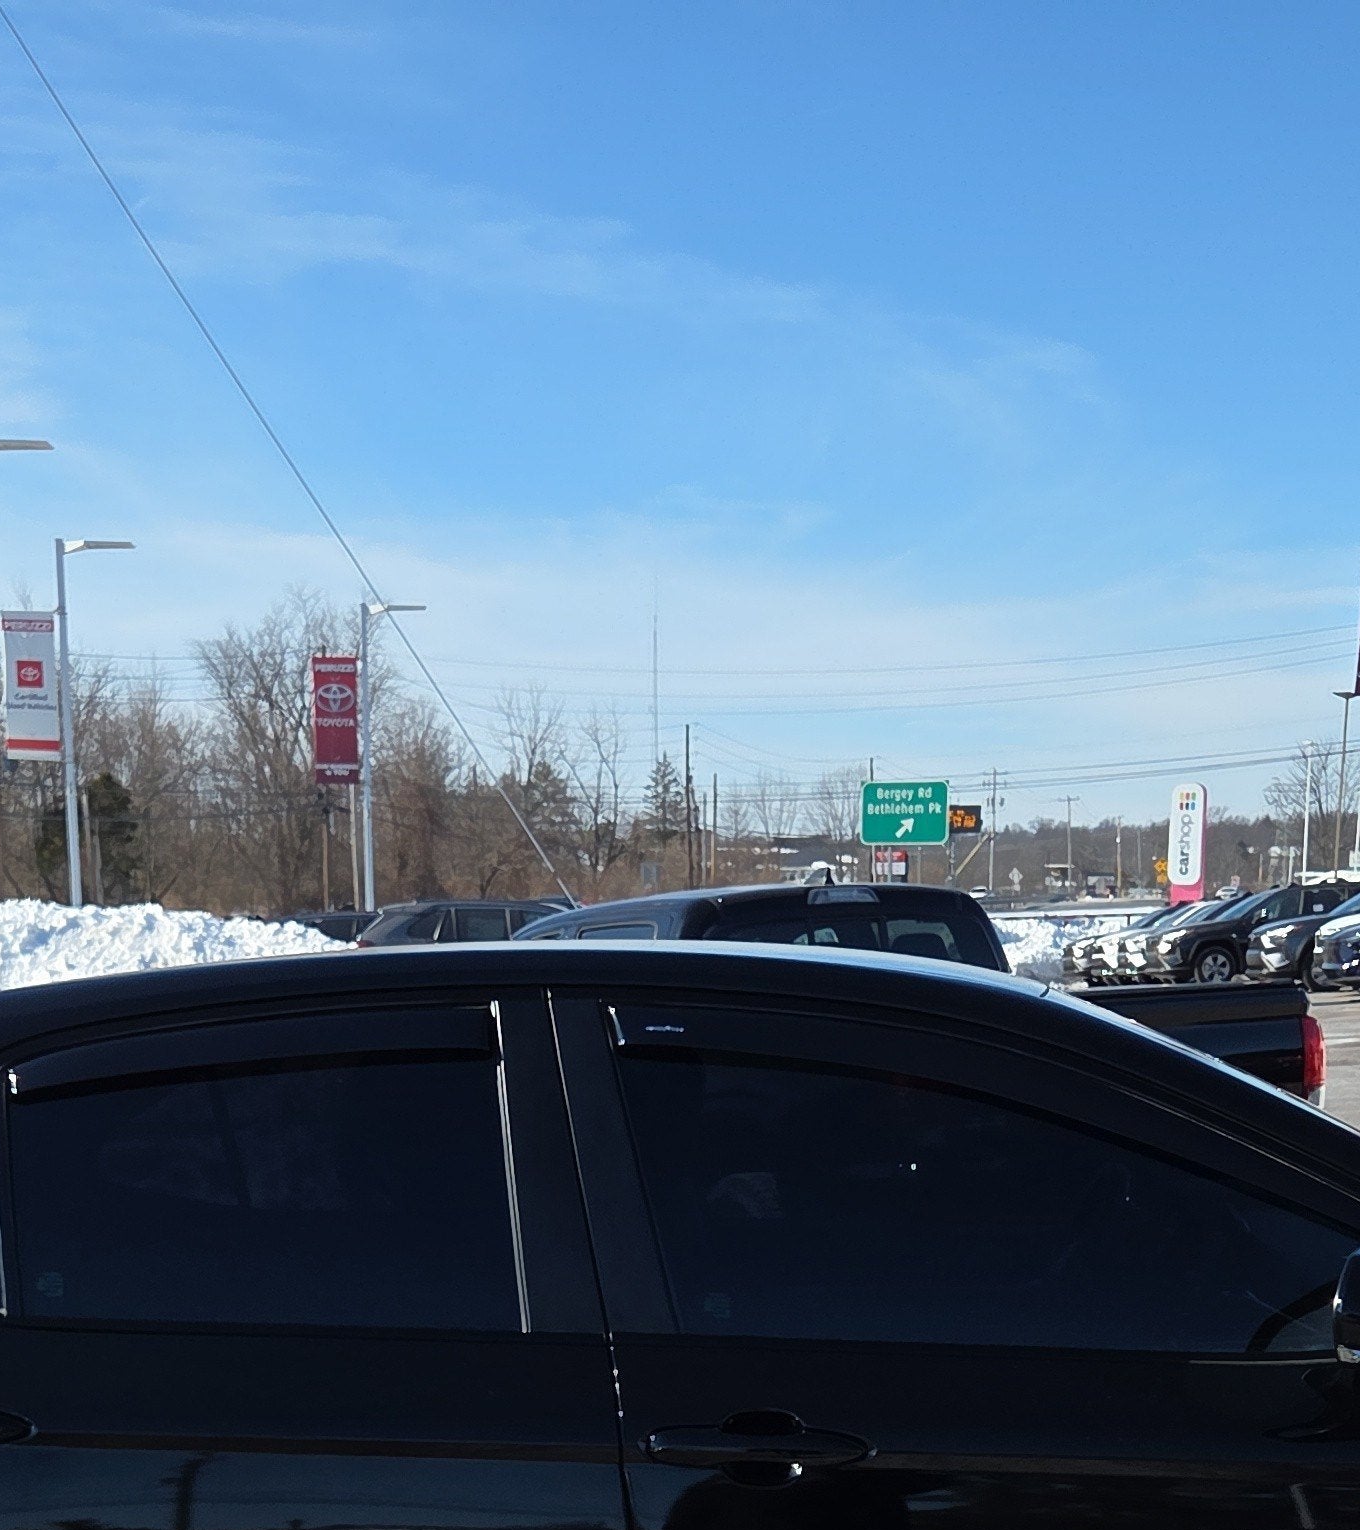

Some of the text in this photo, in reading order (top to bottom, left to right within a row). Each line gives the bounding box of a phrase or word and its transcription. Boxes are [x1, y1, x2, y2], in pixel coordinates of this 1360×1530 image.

[315, 718, 355, 727] TOYOTA
[876, 786, 932, 801] Bergey Rd
[867, 802, 942, 815] Bethlehem Pk
[1179, 813, 1194, 876] carshop
